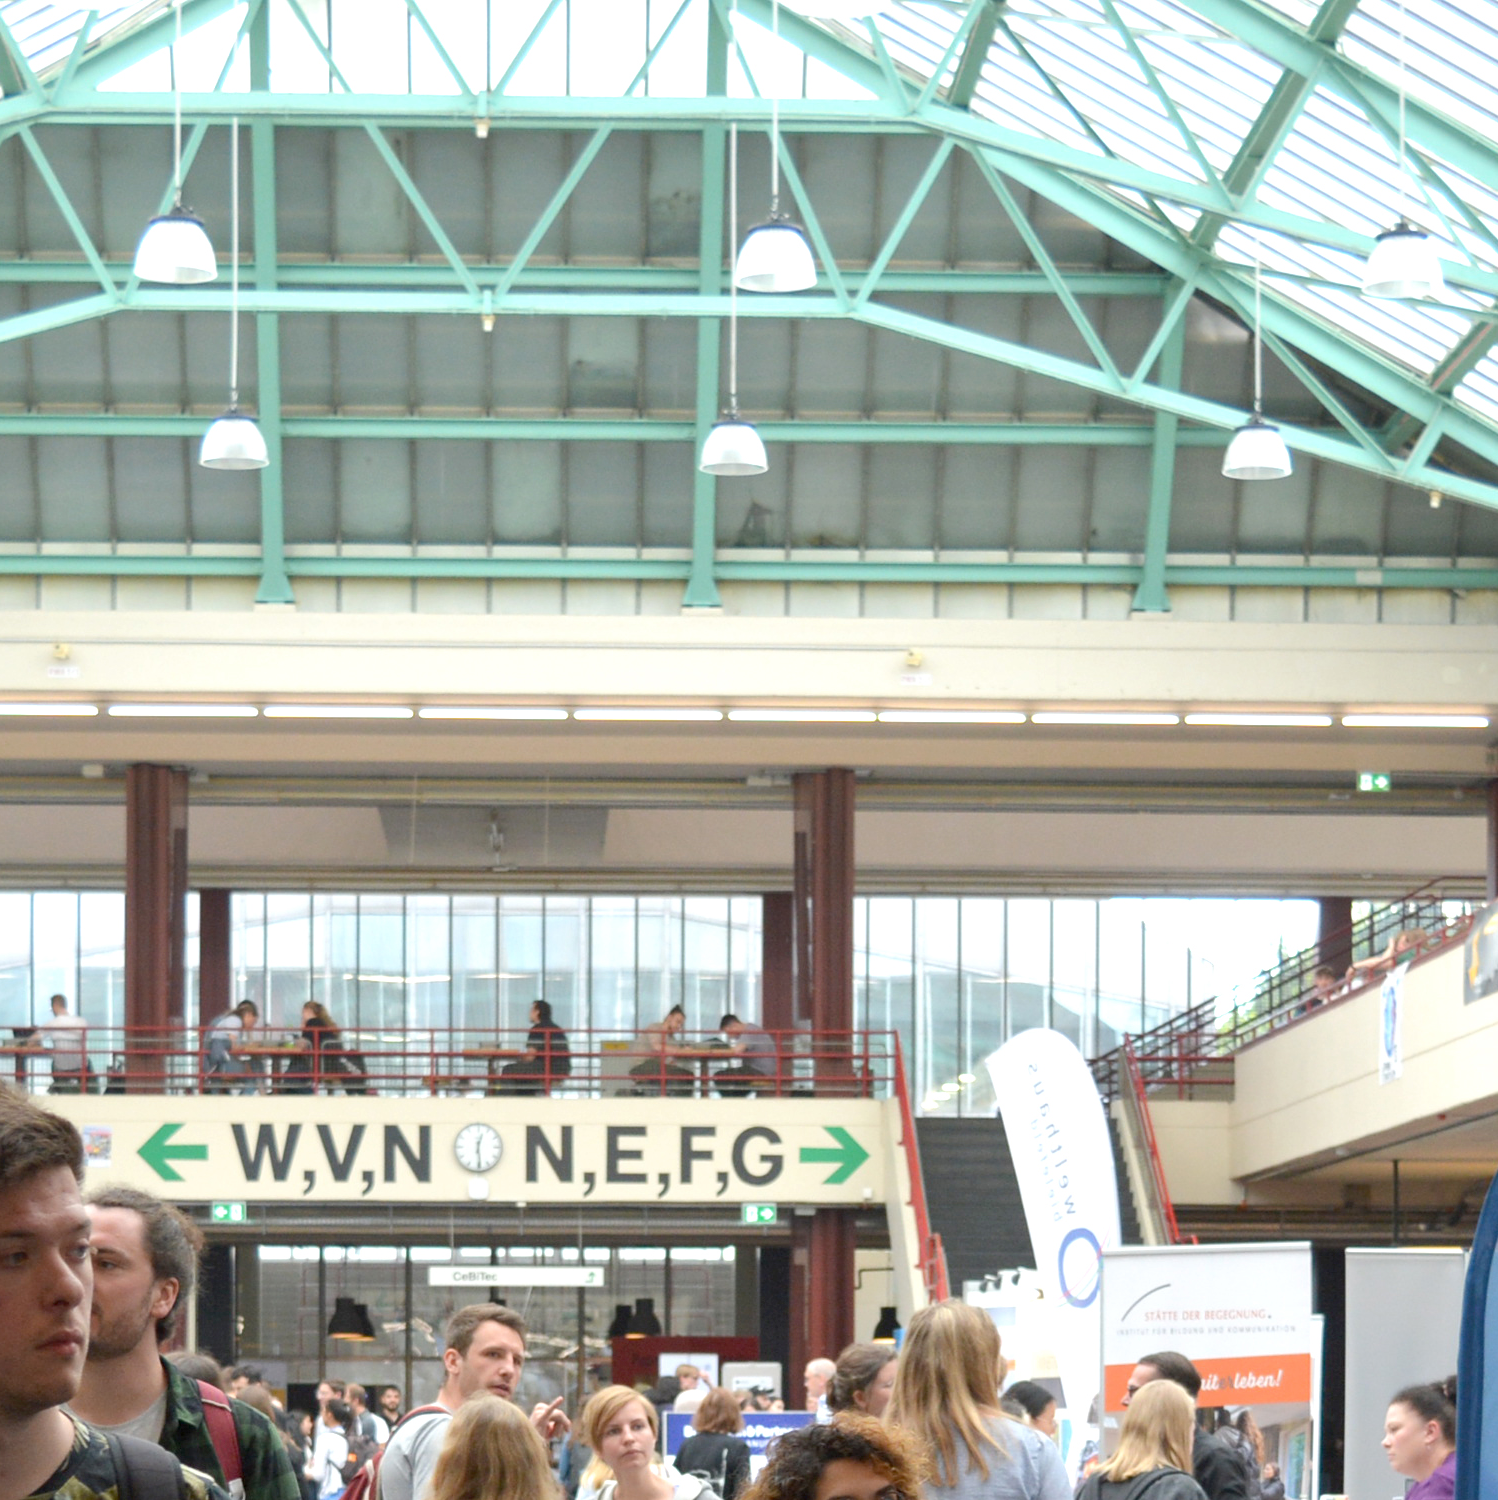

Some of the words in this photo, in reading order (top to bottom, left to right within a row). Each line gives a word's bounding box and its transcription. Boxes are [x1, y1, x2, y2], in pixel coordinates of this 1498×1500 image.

[231, 1123, 432, 1197] W,V,N
[524, 1124, 785, 1197] N,E,F,G
[452, 1271, 498, 1282] CeBiTec
[1144, 1310, 1179, 1322] STÄTTE
[1181, 1310, 1201, 1321] DER
[1207, 1325, 1224, 1335] UND
